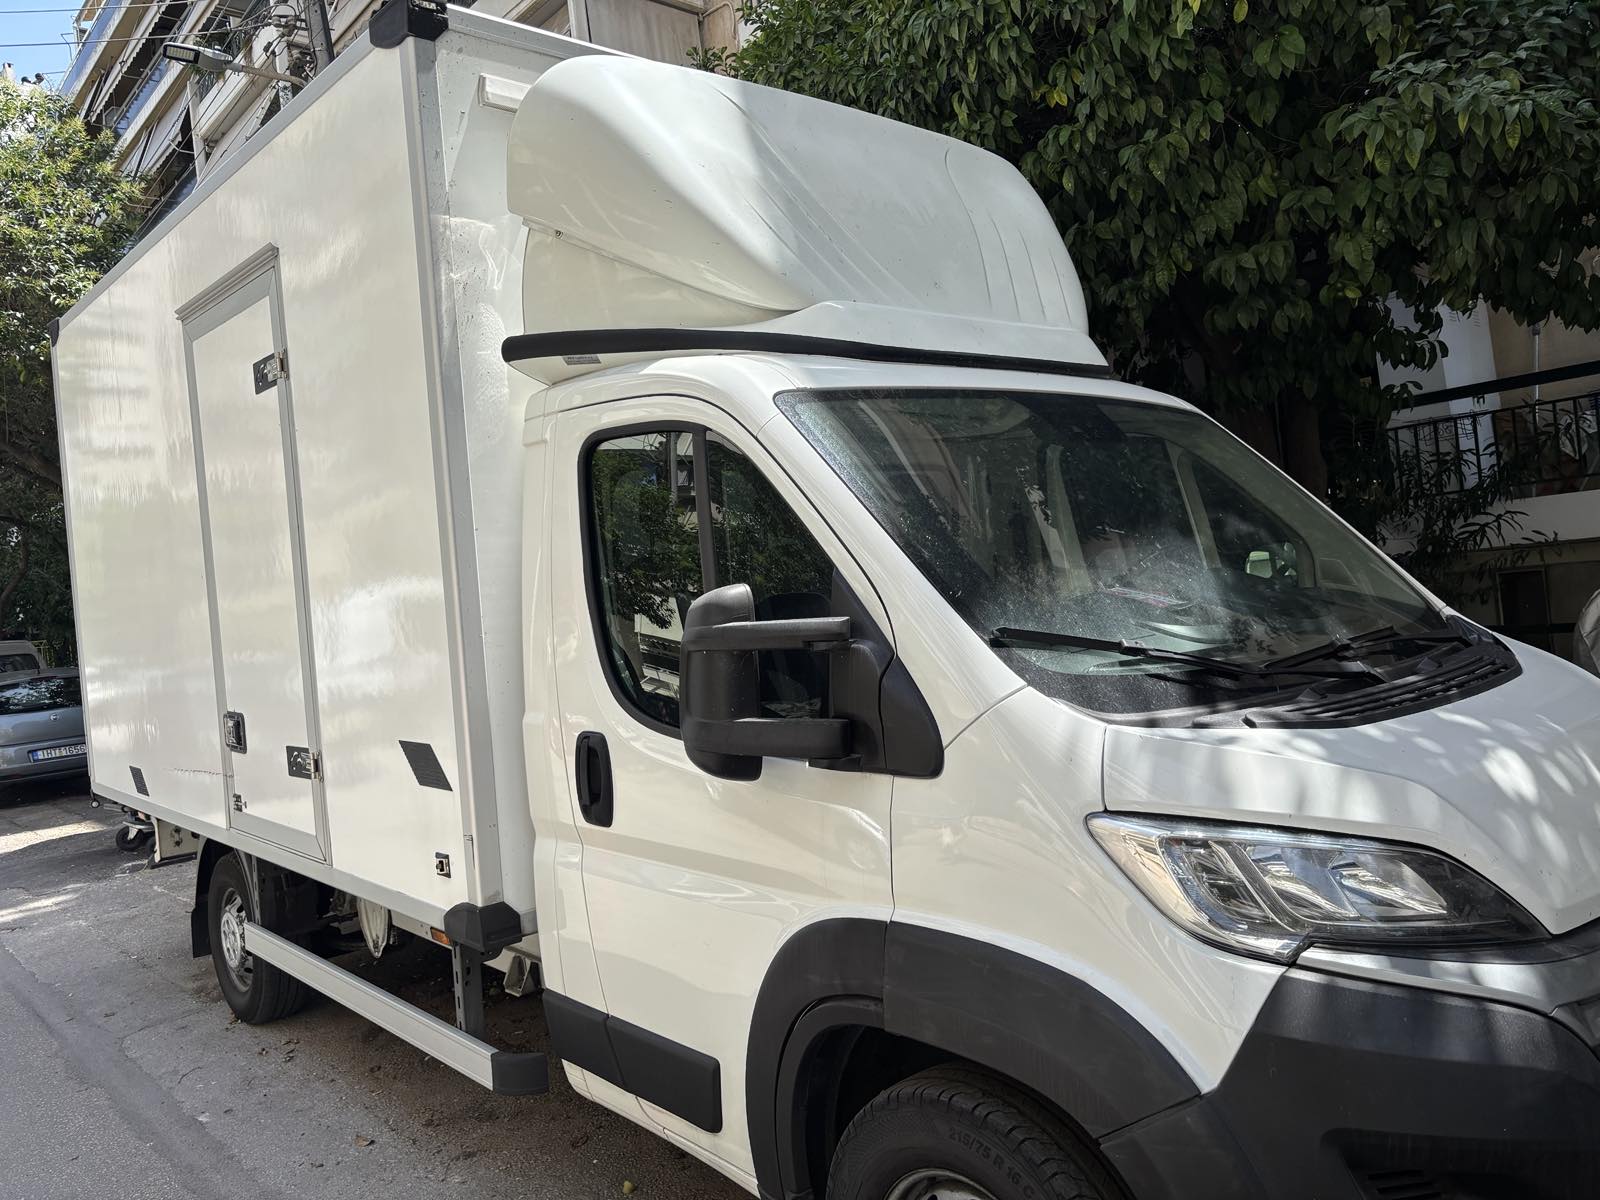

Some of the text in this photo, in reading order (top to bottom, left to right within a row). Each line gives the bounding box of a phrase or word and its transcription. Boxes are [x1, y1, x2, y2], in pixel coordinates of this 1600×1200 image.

[949, 1127, 1035, 1199] 215/75 R 16 C
